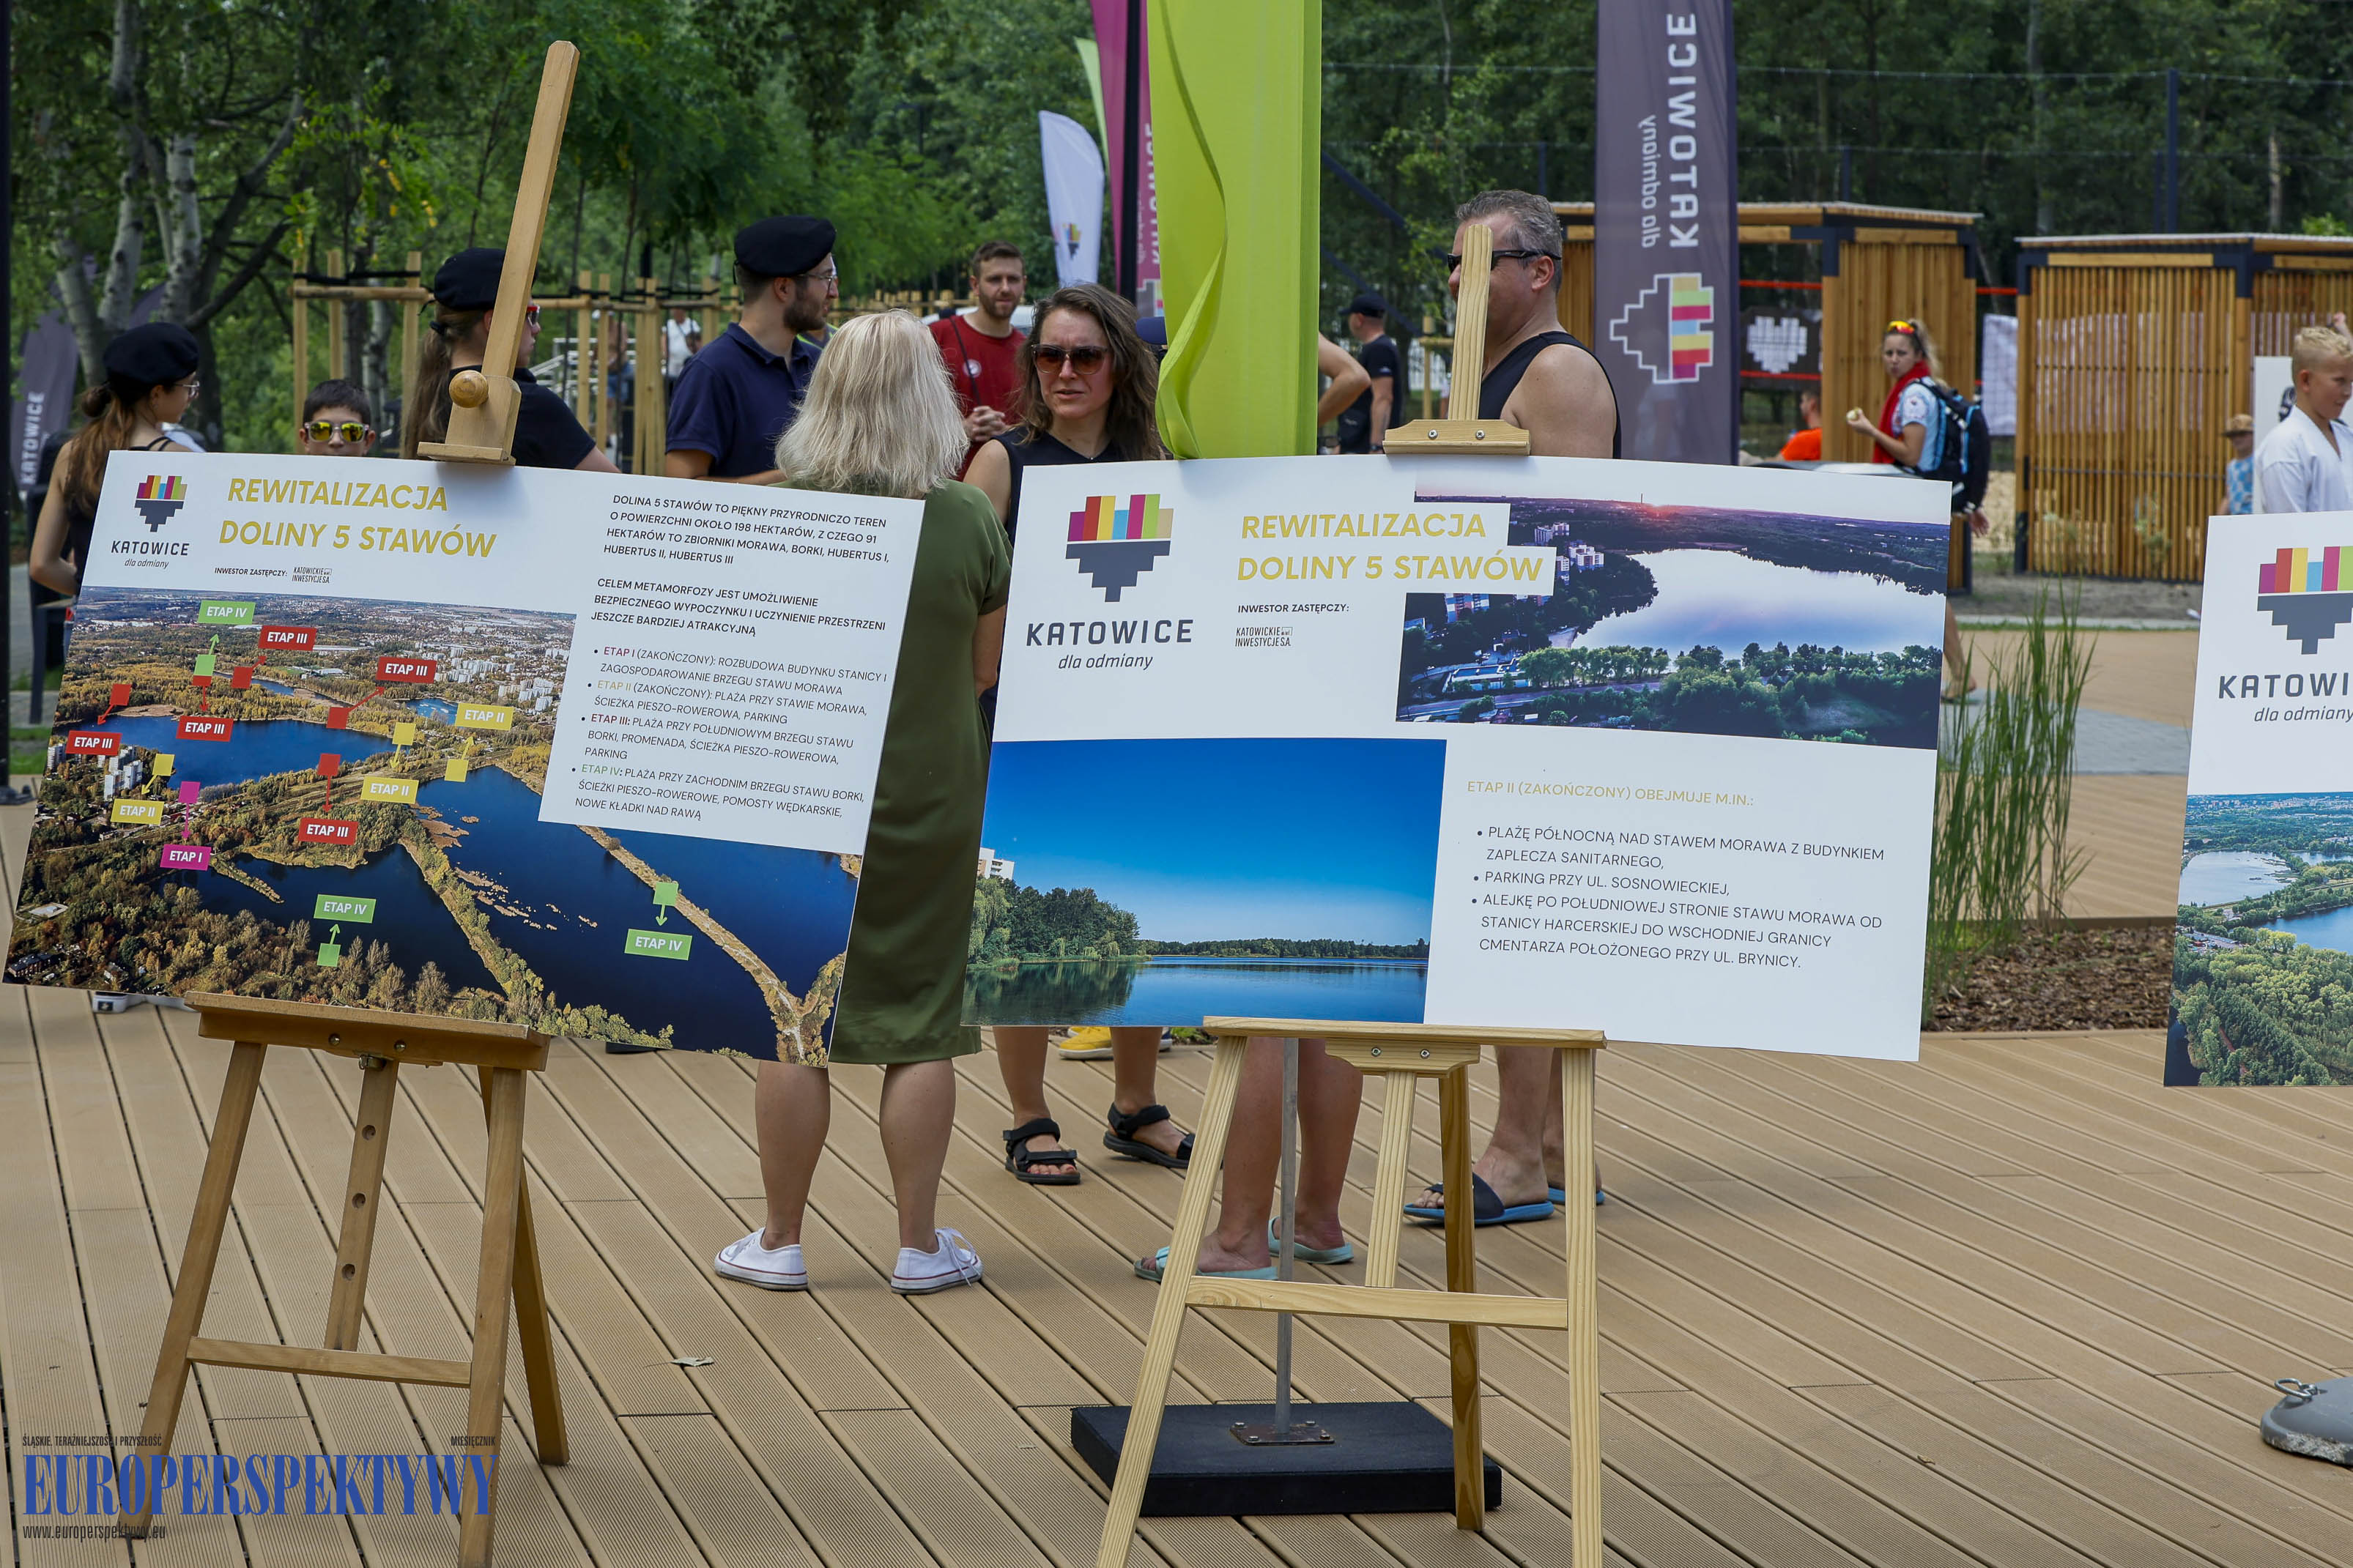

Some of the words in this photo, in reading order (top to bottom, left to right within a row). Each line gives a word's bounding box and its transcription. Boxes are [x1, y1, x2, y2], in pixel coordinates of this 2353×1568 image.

[228, 478, 448, 511] REWITALIZACJA
[612, 494, 652, 506] DOLINA
[654, 498, 662, 508] 5
[663, 499, 713, 511] STAWÓW
[715, 504, 729, 513] TO
[730, 505, 768, 517] PIĘKNY
[768, 508, 852, 524] PRZYRODNICZO
[853, 516, 886, 528] TEREN
[1242, 513, 1486, 539] REWITALIZACJA
[111, 540, 190, 556] KATOWICE
[220, 520, 327, 548] DOLINY
[333, 525, 351, 549] 5
[357, 524, 497, 558] STAWÓW
[125, 558, 136, 566] dla
[137, 559, 169, 569] odmiany
[249, 568, 288, 577] ZASTĘPCZY:
[293, 567, 325, 575] KATOWICKIE
[1237, 556, 1356, 580] DOLINY
[1365, 556, 1382, 579] 5
[1394, 549, 1544, 581] STAWÓW
[597, 578, 633, 590] CELEM
[633, 582, 714, 597] METAMORFOZY
[715, 589, 741, 599] JEST
[741, 591, 819, 607] UMOŻLIWIENIE
[207, 606, 233, 617] ETAP
[235, 608, 247, 617] IV
[594, 595, 671, 610] BEZPIECZNEGO
[673, 601, 748, 617] WYPOCZYNKU
[749, 609, 752, 617] I
[754, 609, 816, 624] UCZYNIENIE
[817, 616, 886, 631] PRZESTRZENI
[1238, 604, 1289, 613] INWESTOR
[1292, 603, 1349, 614] ZASTĘPCZY:
[590, 612, 635, 623] JESZCZE
[636, 614, 685, 628] BARDZIEJ
[686, 620, 756, 637] ATRAKCYJNĄ
[1026, 619, 1193, 646] KATOWICE
[1236, 627, 1281, 636] KATOWICKIE
[267, 631, 294, 643] ETAP
[296, 633, 308, 644] III
[385, 663, 415, 675] ETAP
[416, 665, 429, 676] III
[1058, 654, 1082, 669] dla
[1086, 653, 1153, 671] odmiany
[600, 663, 711, 682] ZAGOSPODAROWANIE
[712, 674, 754, 686] BRZEGU
[755, 677, 792, 690] STAWU
[793, 682, 842, 696] MORAWA
[464, 710, 494, 721] ETAP
[497, 713, 504, 722] II
[594, 694, 634, 709] ŚCIEŻKA
[637, 701, 741, 721] PIESZO-ROWEROWA,
[744, 711, 788, 724] PARKING
[2254, 707, 2278, 721] dla
[2283, 705, 2353, 724] odmiany
[185, 722, 212, 733] ETAP
[213, 724, 225, 735] III
[590, 713, 618, 724] ETAP
[618, 716, 631, 726] III:
[632, 717, 664, 729] PLAŻA
[665, 721, 691, 731] PRZY
[693, 723, 772, 740] POŁUDNIOWYM
[773, 732, 815, 744] BRZEGU
[816, 736, 854, 748] STAWU
[74, 737, 100, 748] ETAP
[102, 738, 114, 748] III
[585, 747, 628, 759] PARKING
[588, 730, 618, 743] BORKI,
[621, 733, 686, 750] PROMENADA,
[689, 738, 731, 753] ŚCIEŻKA
[733, 745, 839, 765] PIESZO-ROWEROWA,
[371, 783, 399, 795] ETAP
[401, 786, 410, 795] II
[582, 764, 608, 774] ETAP
[609, 767, 623, 776] IV:
[624, 768, 656, 780] PLAŻA
[659, 771, 683, 782] PRZY
[685, 774, 749, 789] ZACHODNIM
[749, 781, 790, 794] BRZEGU
[792, 786, 830, 798] STAWU
[831, 789, 864, 803] BORKI,
[1467, 781, 1503, 792] ETAP
[1507, 783, 1514, 793] II
[1519, 781, 1631, 800] (ZAKOŃCZONY)
[1635, 789, 1711, 803] OBEJMUJE
[1716, 793, 1753, 806] M.IN.:
[578, 779, 615, 792] ŚCIEŻKI
[617, 784, 719, 805] PIESZO-ROWEROWE,
[722, 795, 774, 809] POMOSTY
[776, 801, 842, 818] WĘDKARSKIE,
[119, 803, 147, 816] ETAP
[148, 807, 155, 817] II
[575, 798, 607, 809] NOWE
[608, 801, 645, 813] KŁADKI
[646, 805, 670, 815] NAD
[670, 807, 701, 821] RAWĄ
[306, 824, 336, 836] ETAP
[337, 826, 349, 837] III
[1489, 825, 1530, 841] PLAŻĘ
[1535, 826, 1615, 846] PÓŁNOCNĄ
[1619, 832, 1650, 844] NAD
[1653, 834, 1716, 849] STAWEM
[1720, 838, 1787, 854] MORAWA
[1790, 843, 1799, 854] Z
[1803, 844, 1884, 861] BUDYNKIEM
[169, 850, 196, 862] ETAP
[198, 852, 203, 863] I
[1486, 849, 1557, 863] ZAPLECZA
[1561, 852, 1664, 869] SANITARNEGO,
[1485, 871, 1545, 885] PARKING
[1549, 874, 1583, 886] PRZY
[1587, 875, 1607, 888] UL.
[1611, 877, 1730, 896] SOSNOWIECKIEJ,
[324, 902, 352, 913] ETAP
[355, 904, 367, 914] IV
[1483, 893, 1533, 910] ALEJKĘ
[1537, 896, 1557, 907] PO
[1560, 896, 1665, 913] POŁUDNIOWEJ
[1669, 902, 1729, 918] STRONIE
[1733, 907, 1784, 921] STAWU
[1788, 910, 1856, 926] MORAWA
[1860, 916, 1882, 928] OD
[1481, 915, 1541, 929] STANICY
[1544, 918, 1637, 935] HARCERSKIEJ
[1642, 924, 1664, 936] DO
[1668, 925, 1764, 943] WSCHODNIEJ
[1768, 932, 1831, 948] GRANICY
[635, 937, 666, 949] ETAP
[669, 940, 682, 951] IV
[1480, 938, 1565, 954] CMENTARZA
[1570, 942, 1671, 959] POŁOŻONEGO
[1675, 948, 1710, 962] PRZY
[1713, 951, 1734, 963] UL.
[1738, 952, 1801, 968] BRYNICY.
